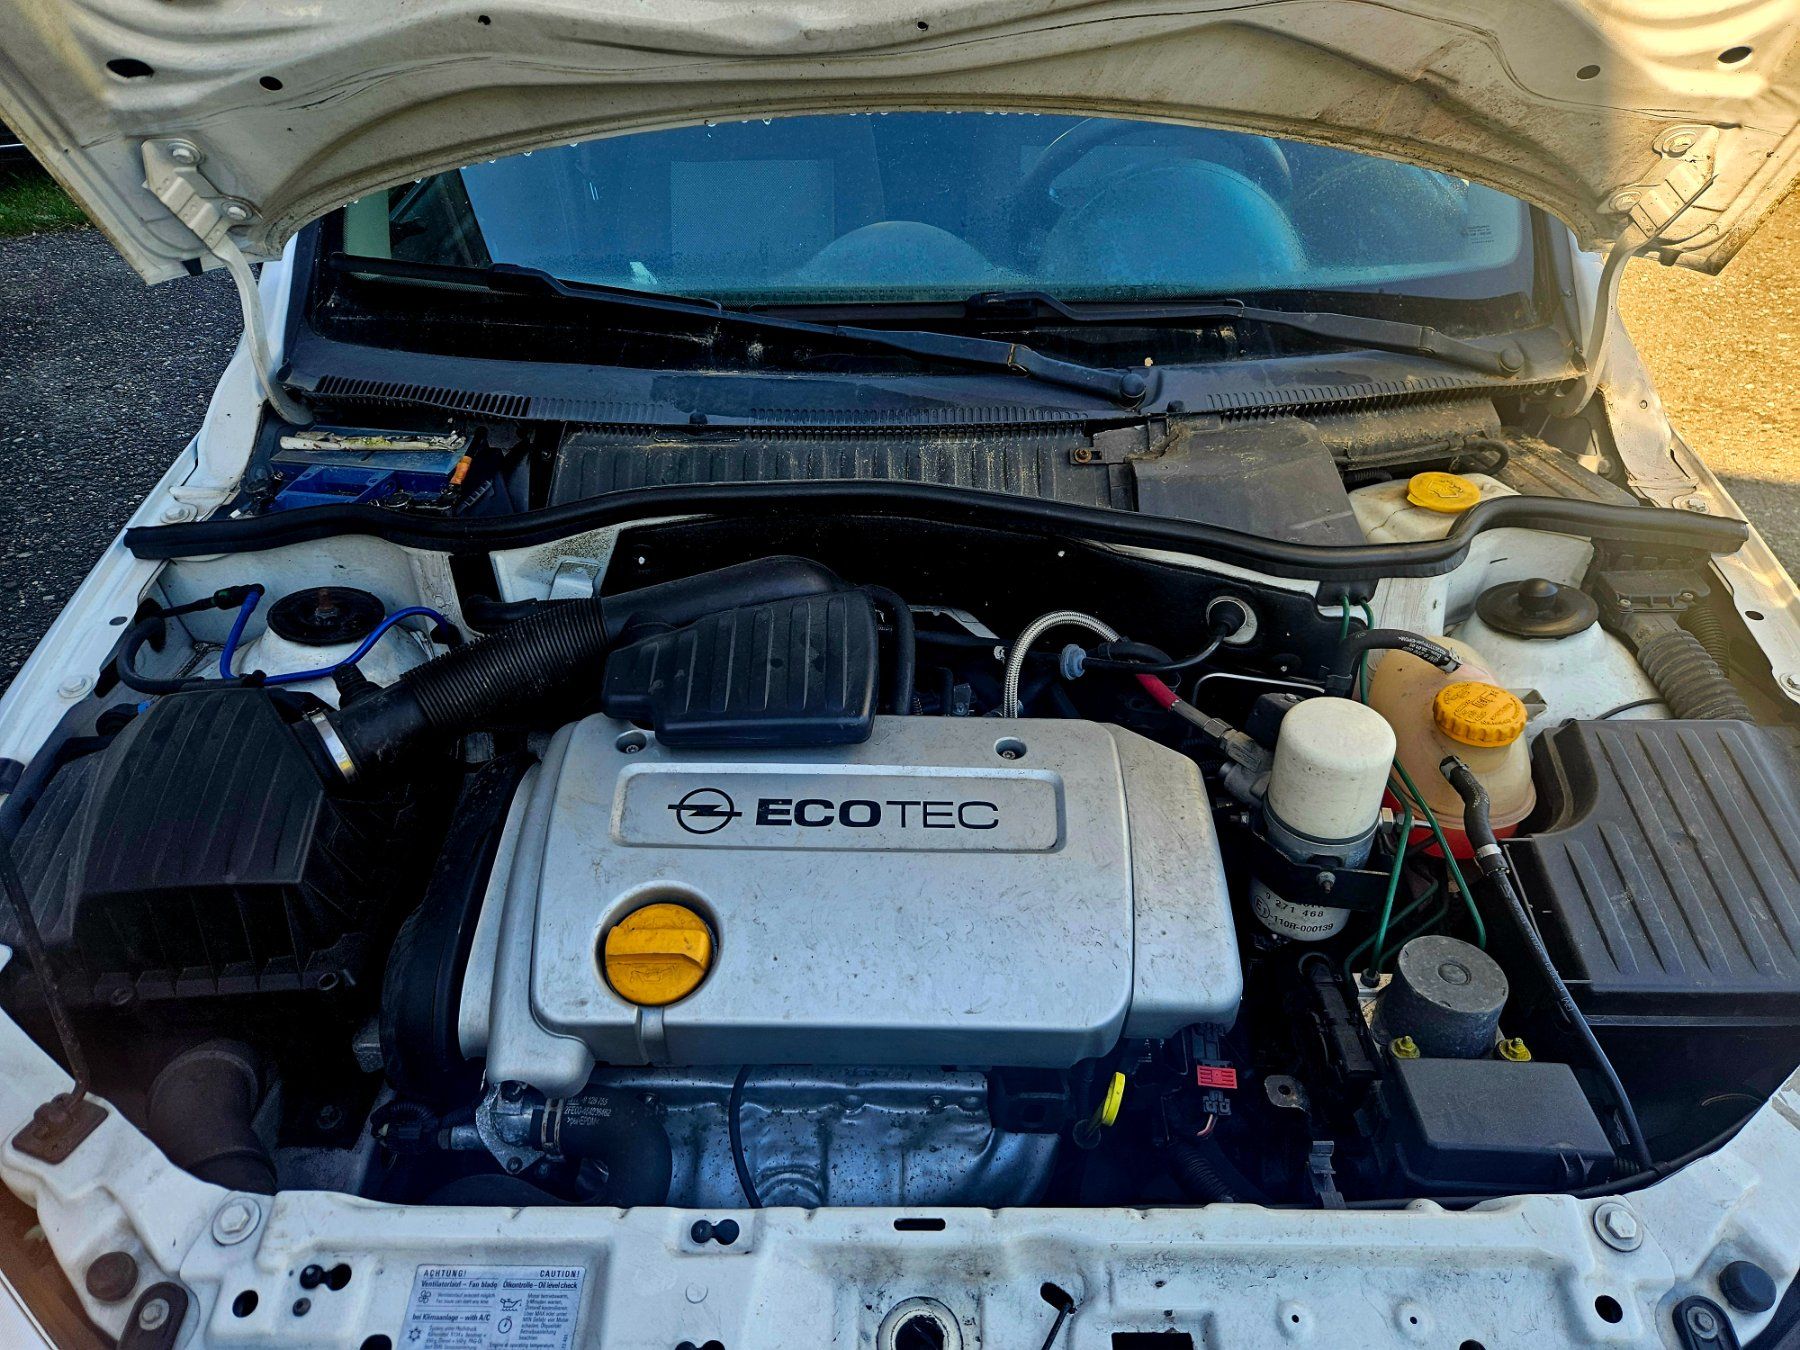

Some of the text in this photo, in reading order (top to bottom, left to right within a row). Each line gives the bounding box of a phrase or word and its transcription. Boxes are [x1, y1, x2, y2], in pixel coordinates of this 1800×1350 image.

[755, 798, 999, 830] ECOTEC
[1275, 899, 1296, 913] 271
[1302, 910, 1324, 918] 468
[423, 1269, 467, 1278] ACHTUNG!
[539, 1270, 581, 1278] CAUTION!
[538, 1281, 547, 1289] Oil
[547, 1281, 560, 1289] level
[560, 1281, 578, 1289] check
[422, 1313, 459, 1322] Klimaanlage
[464, 1313, 478, 1321] with
[478, 1313, 491, 1321] A/C
